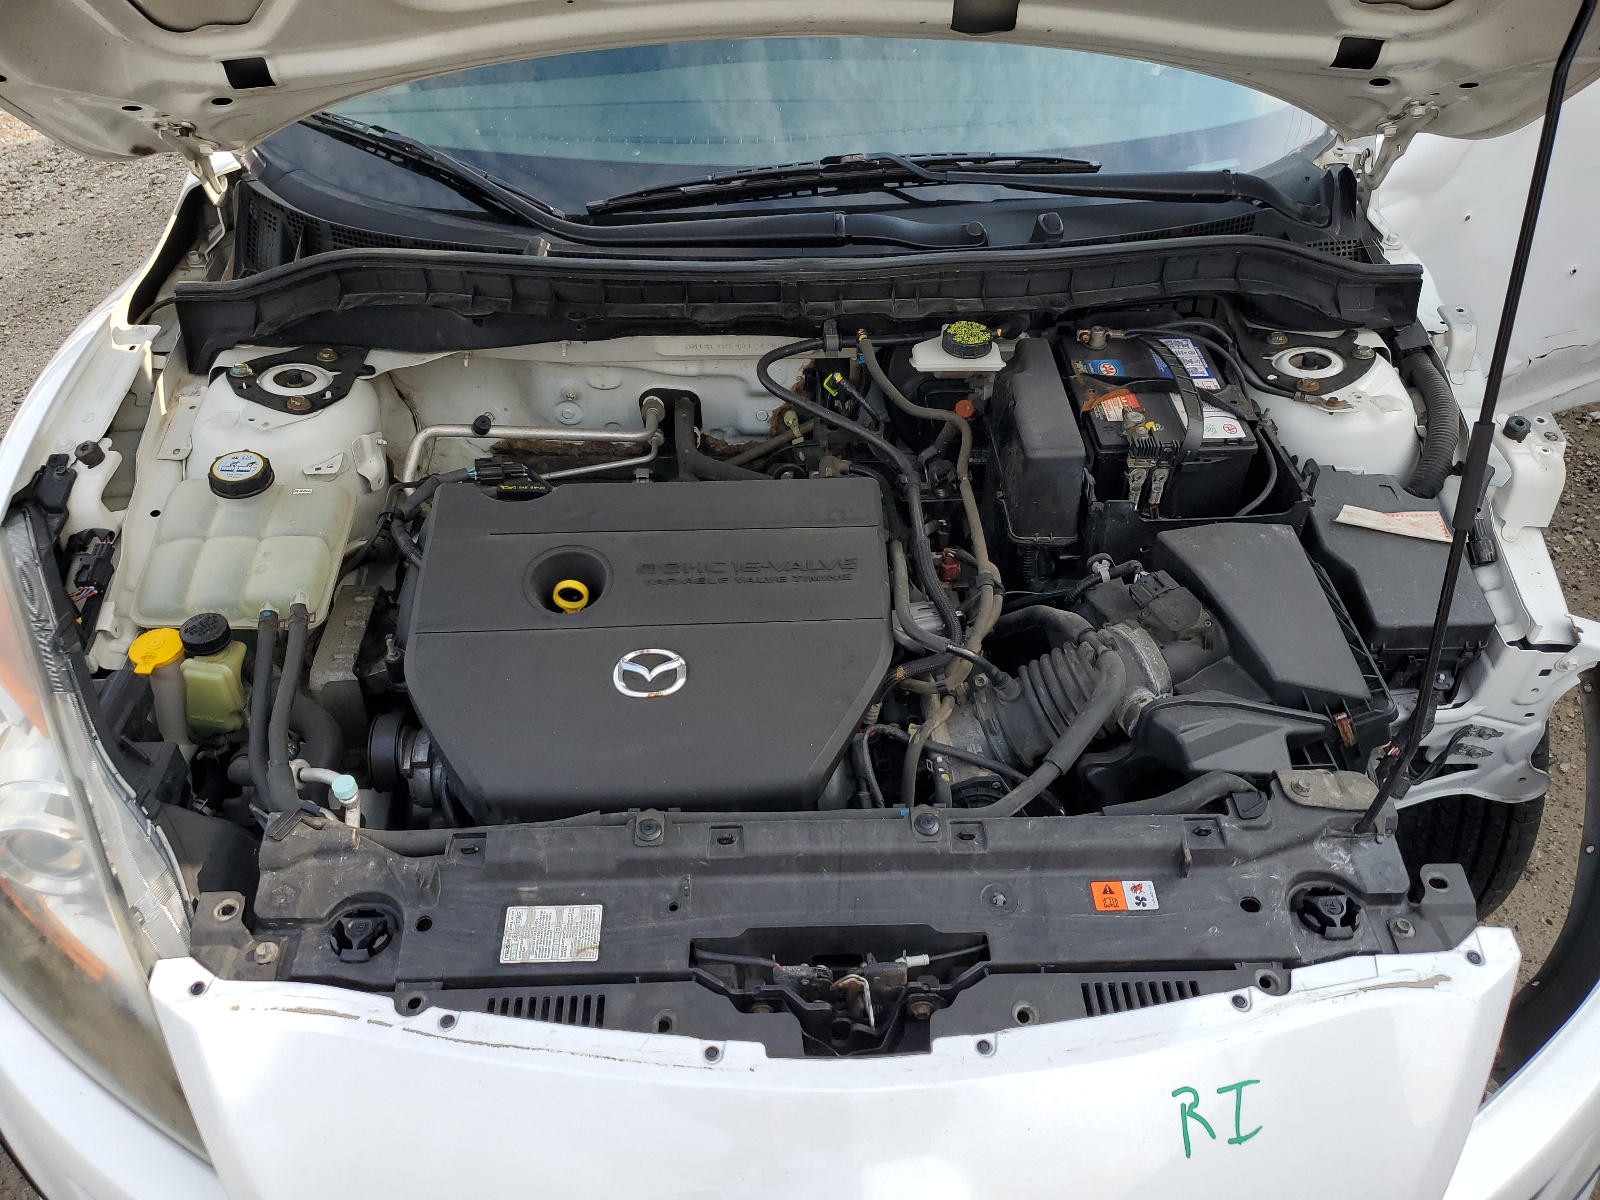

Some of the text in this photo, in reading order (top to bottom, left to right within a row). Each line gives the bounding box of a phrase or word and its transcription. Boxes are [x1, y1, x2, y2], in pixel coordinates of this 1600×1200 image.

[636, 562, 726, 575] DOHC
[644, 577, 729, 587] VARIABLE
[734, 575, 788, 585] VALVE
